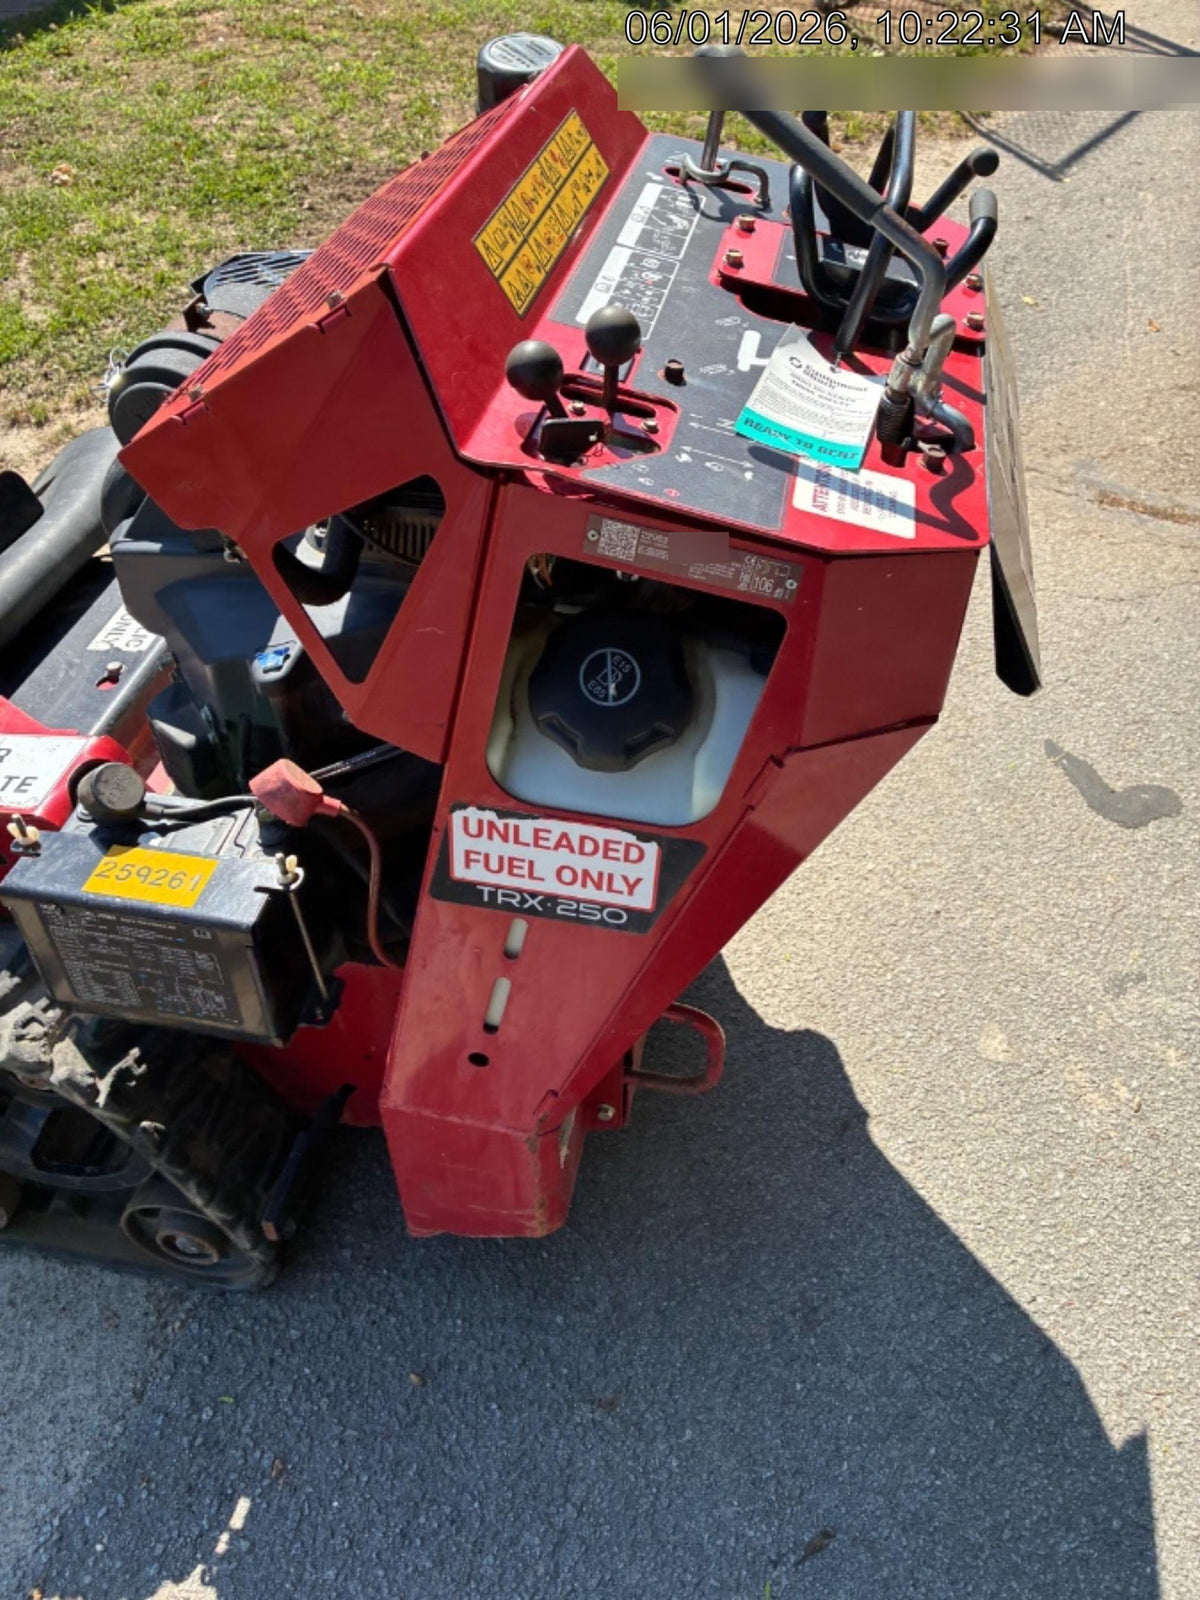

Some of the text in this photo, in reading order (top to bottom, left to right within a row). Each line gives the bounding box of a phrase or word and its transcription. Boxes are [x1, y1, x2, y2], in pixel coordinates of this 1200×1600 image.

[462, 815, 646, 865] UNLEADED
[95, 861, 205, 892] 259261
[463, 849, 644, 897] FUEL ONLY
